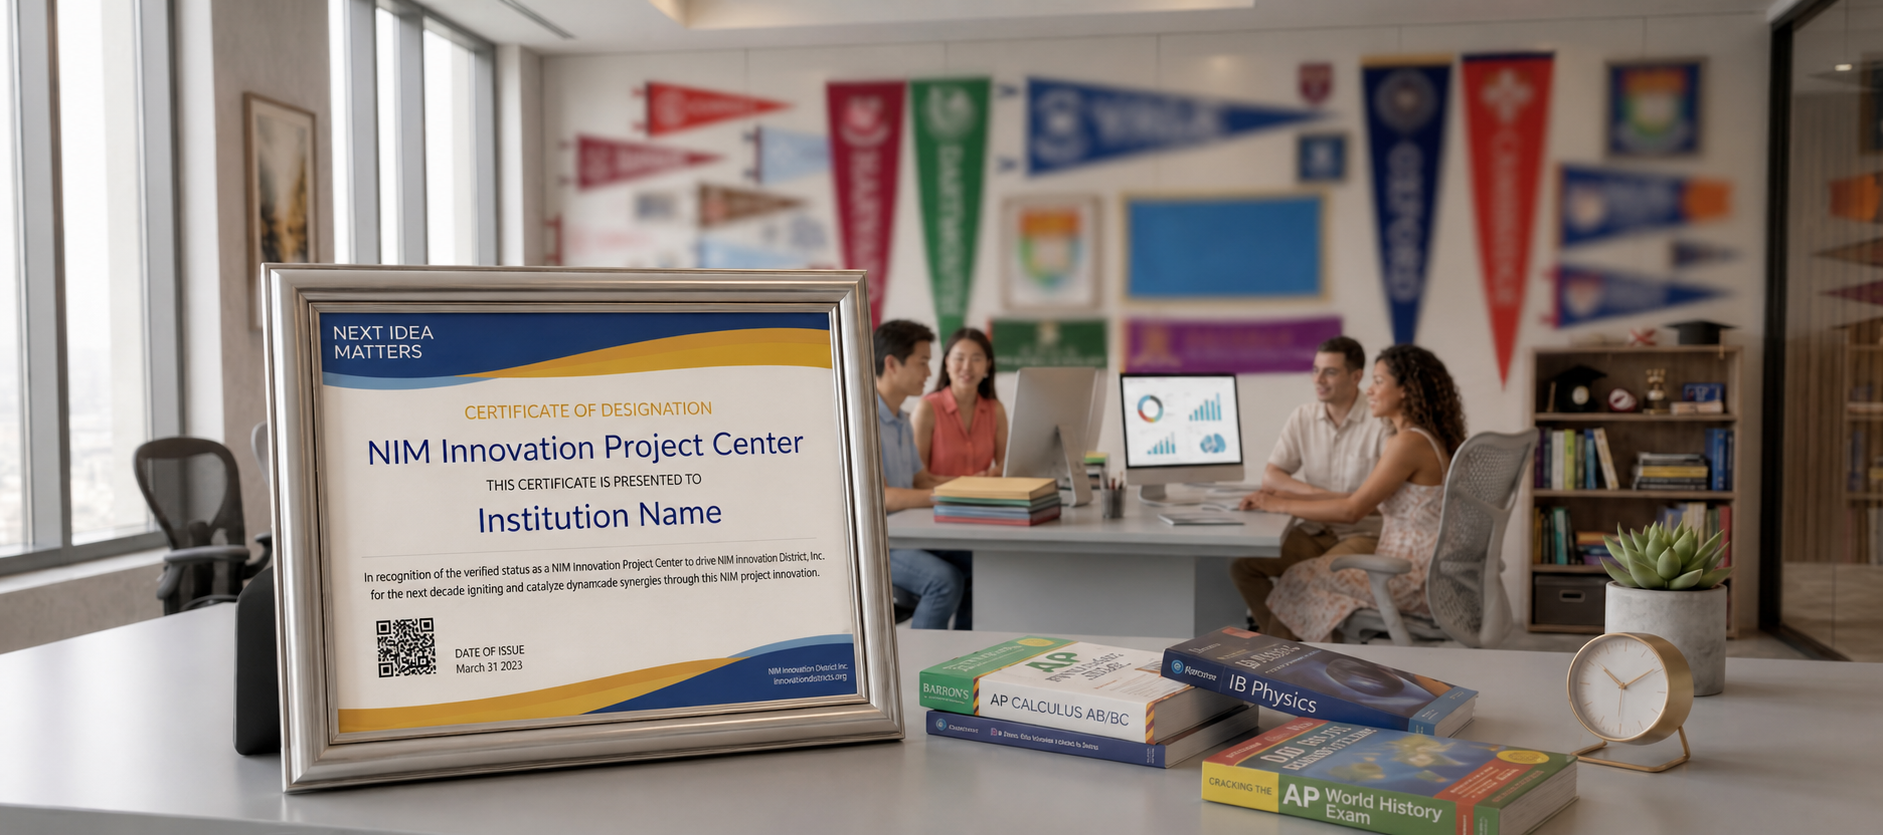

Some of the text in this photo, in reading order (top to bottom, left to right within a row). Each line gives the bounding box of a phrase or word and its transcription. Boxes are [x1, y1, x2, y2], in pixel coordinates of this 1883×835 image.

[333, 325, 433, 340] NEXT IDEA
[334, 344, 422, 359] MATTERS
[464, 401, 711, 420] CERTIFICATE OF DESIGNATION
[368, 431, 803, 465] NIM Innovation Project Center
[485, 473, 701, 491] THIS CERTIFICATE IS PRESENTED TO
[479, 501, 721, 533] Institution Name
[364, 572, 373, 582] In
[375, 569, 431, 583] recognition
[433, 567, 443, 579] of
[445, 567, 461, 578] the
[463, 565, 499, 577] verified
[501, 565, 530, 575] status
[531, 565, 542, 574] as
[543, 565, 549, 573] a
[551, 562, 570, 572] NIM
[572, 559, 620, 571] Innovation
[622, 558, 653, 571] Project
[654, 557, 683, 567] Center
[684, 558, 694, 566] to
[695, 555, 716, 565] drive
[717, 554, 734, 564] NIM
[735, 553, 777, 563] innovation
[810, 551, 825, 560] Inc.
[370, 588, 385, 600] for
[386, 588, 403, 599] the
[405, 588, 427, 598] next
[429, 585, 465, 597] decade
[467, 583, 503, 597] igniting
[505, 581, 523, 592] and
[526, 580, 564, 593] catalyze
[619, 575, 661, 589] synergies
[663, 573, 699, 586] through
[701, 572, 717, 582] this
[719, 571, 738, 581] NIM
[740, 570, 771, 583] project
[772, 567, 819, 579] innovation.
[455, 644, 524, 658] DATE OF ISSUE
[456, 659, 522, 673] March 31 2023
[923, 682, 969, 700] BARRON'S
[1229, 674, 1318, 715] IB Physics
[989, 693, 1129, 726] AP CALCULUS AB/BC
[1208, 776, 1272, 795] CRACKING THE
[1282, 783, 1442, 822] AP World History
[1326, 804, 1372, 826] Exam
